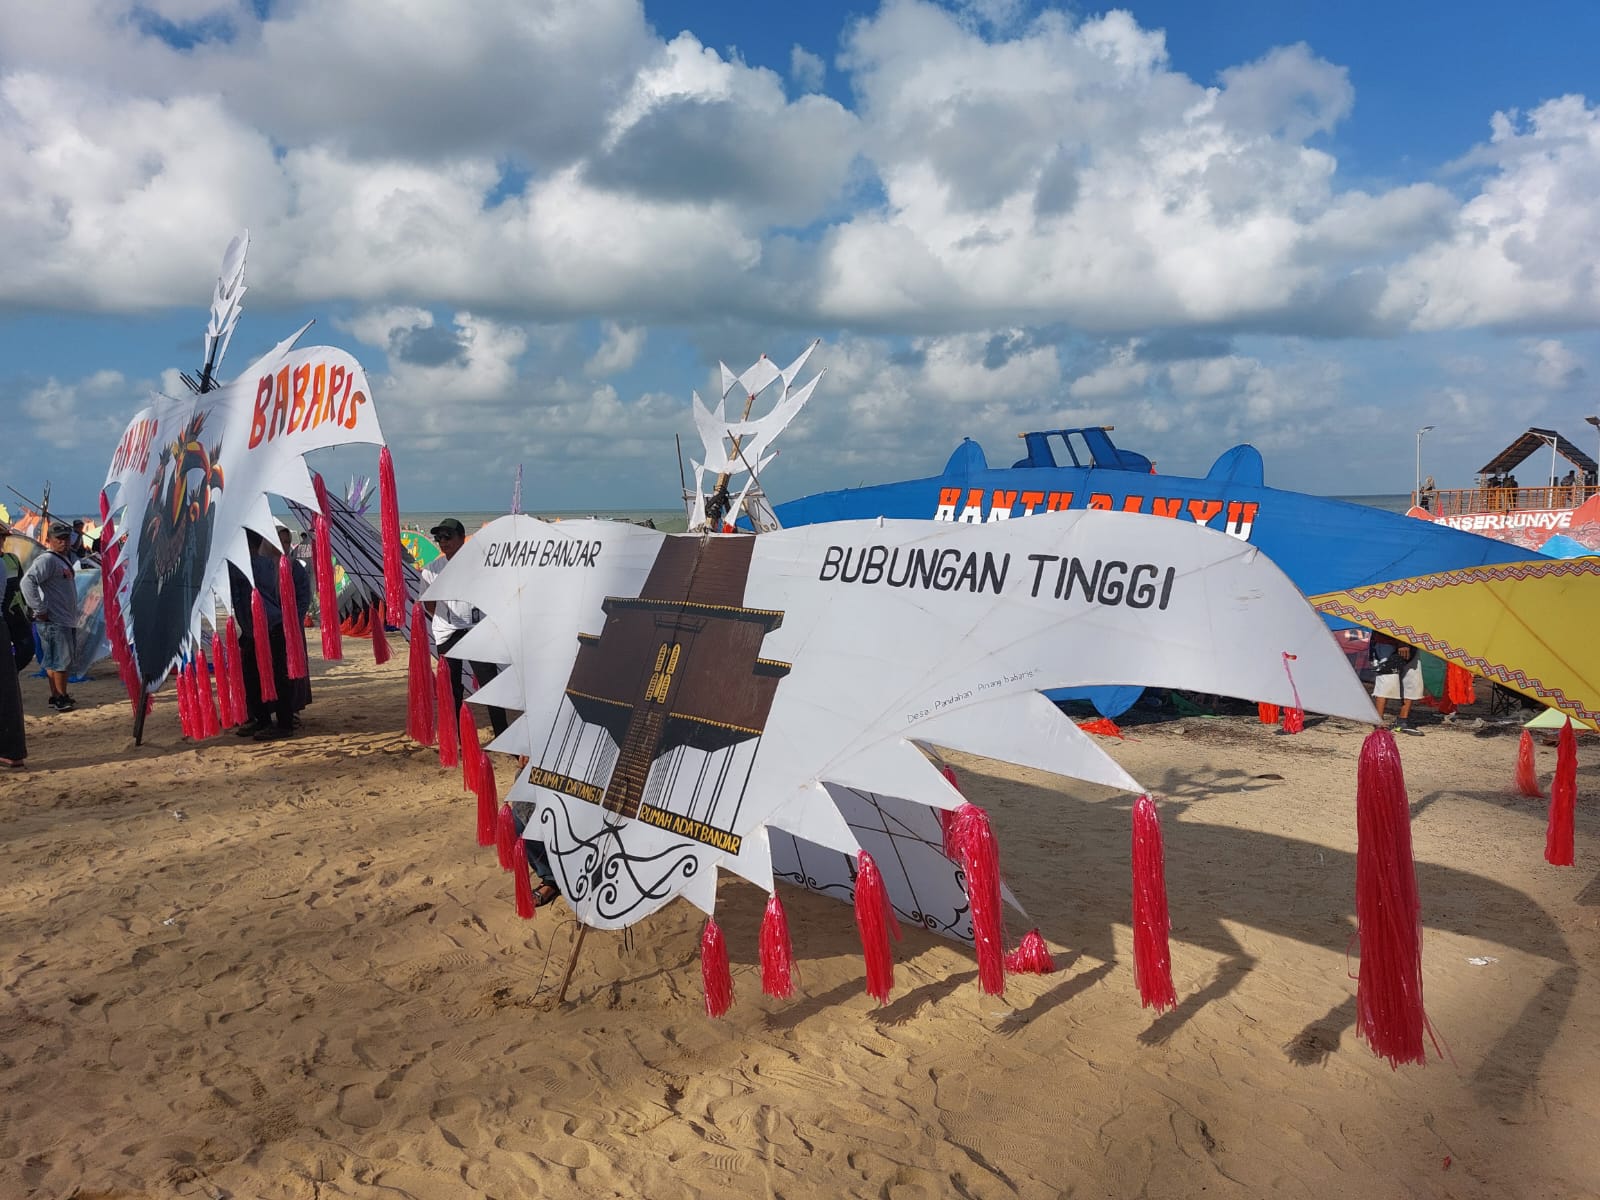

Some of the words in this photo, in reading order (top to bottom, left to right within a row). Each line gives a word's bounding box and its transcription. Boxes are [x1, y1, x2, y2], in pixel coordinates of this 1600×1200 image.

[248, 361, 366, 450] BABARIS
[933, 487, 1074, 525] HANTU
[1428, 512, 1574, 531] ANSERRUNAYE
[484, 540, 541, 567] RUMAH
[538, 539, 602, 568] BANJAR
[819, 545, 1011, 594] BUBUNGAN
[1028, 554, 1176, 610] TINGGI
[907, 709, 929, 723] Desa
[531, 768, 565, 790] SELAMAT
[565, 778, 596, 801] DATANG
[639, 803, 674, 829] RUMAH
[672, 816, 703, 838] ADAT
[700, 825, 740, 854] BANJAR
